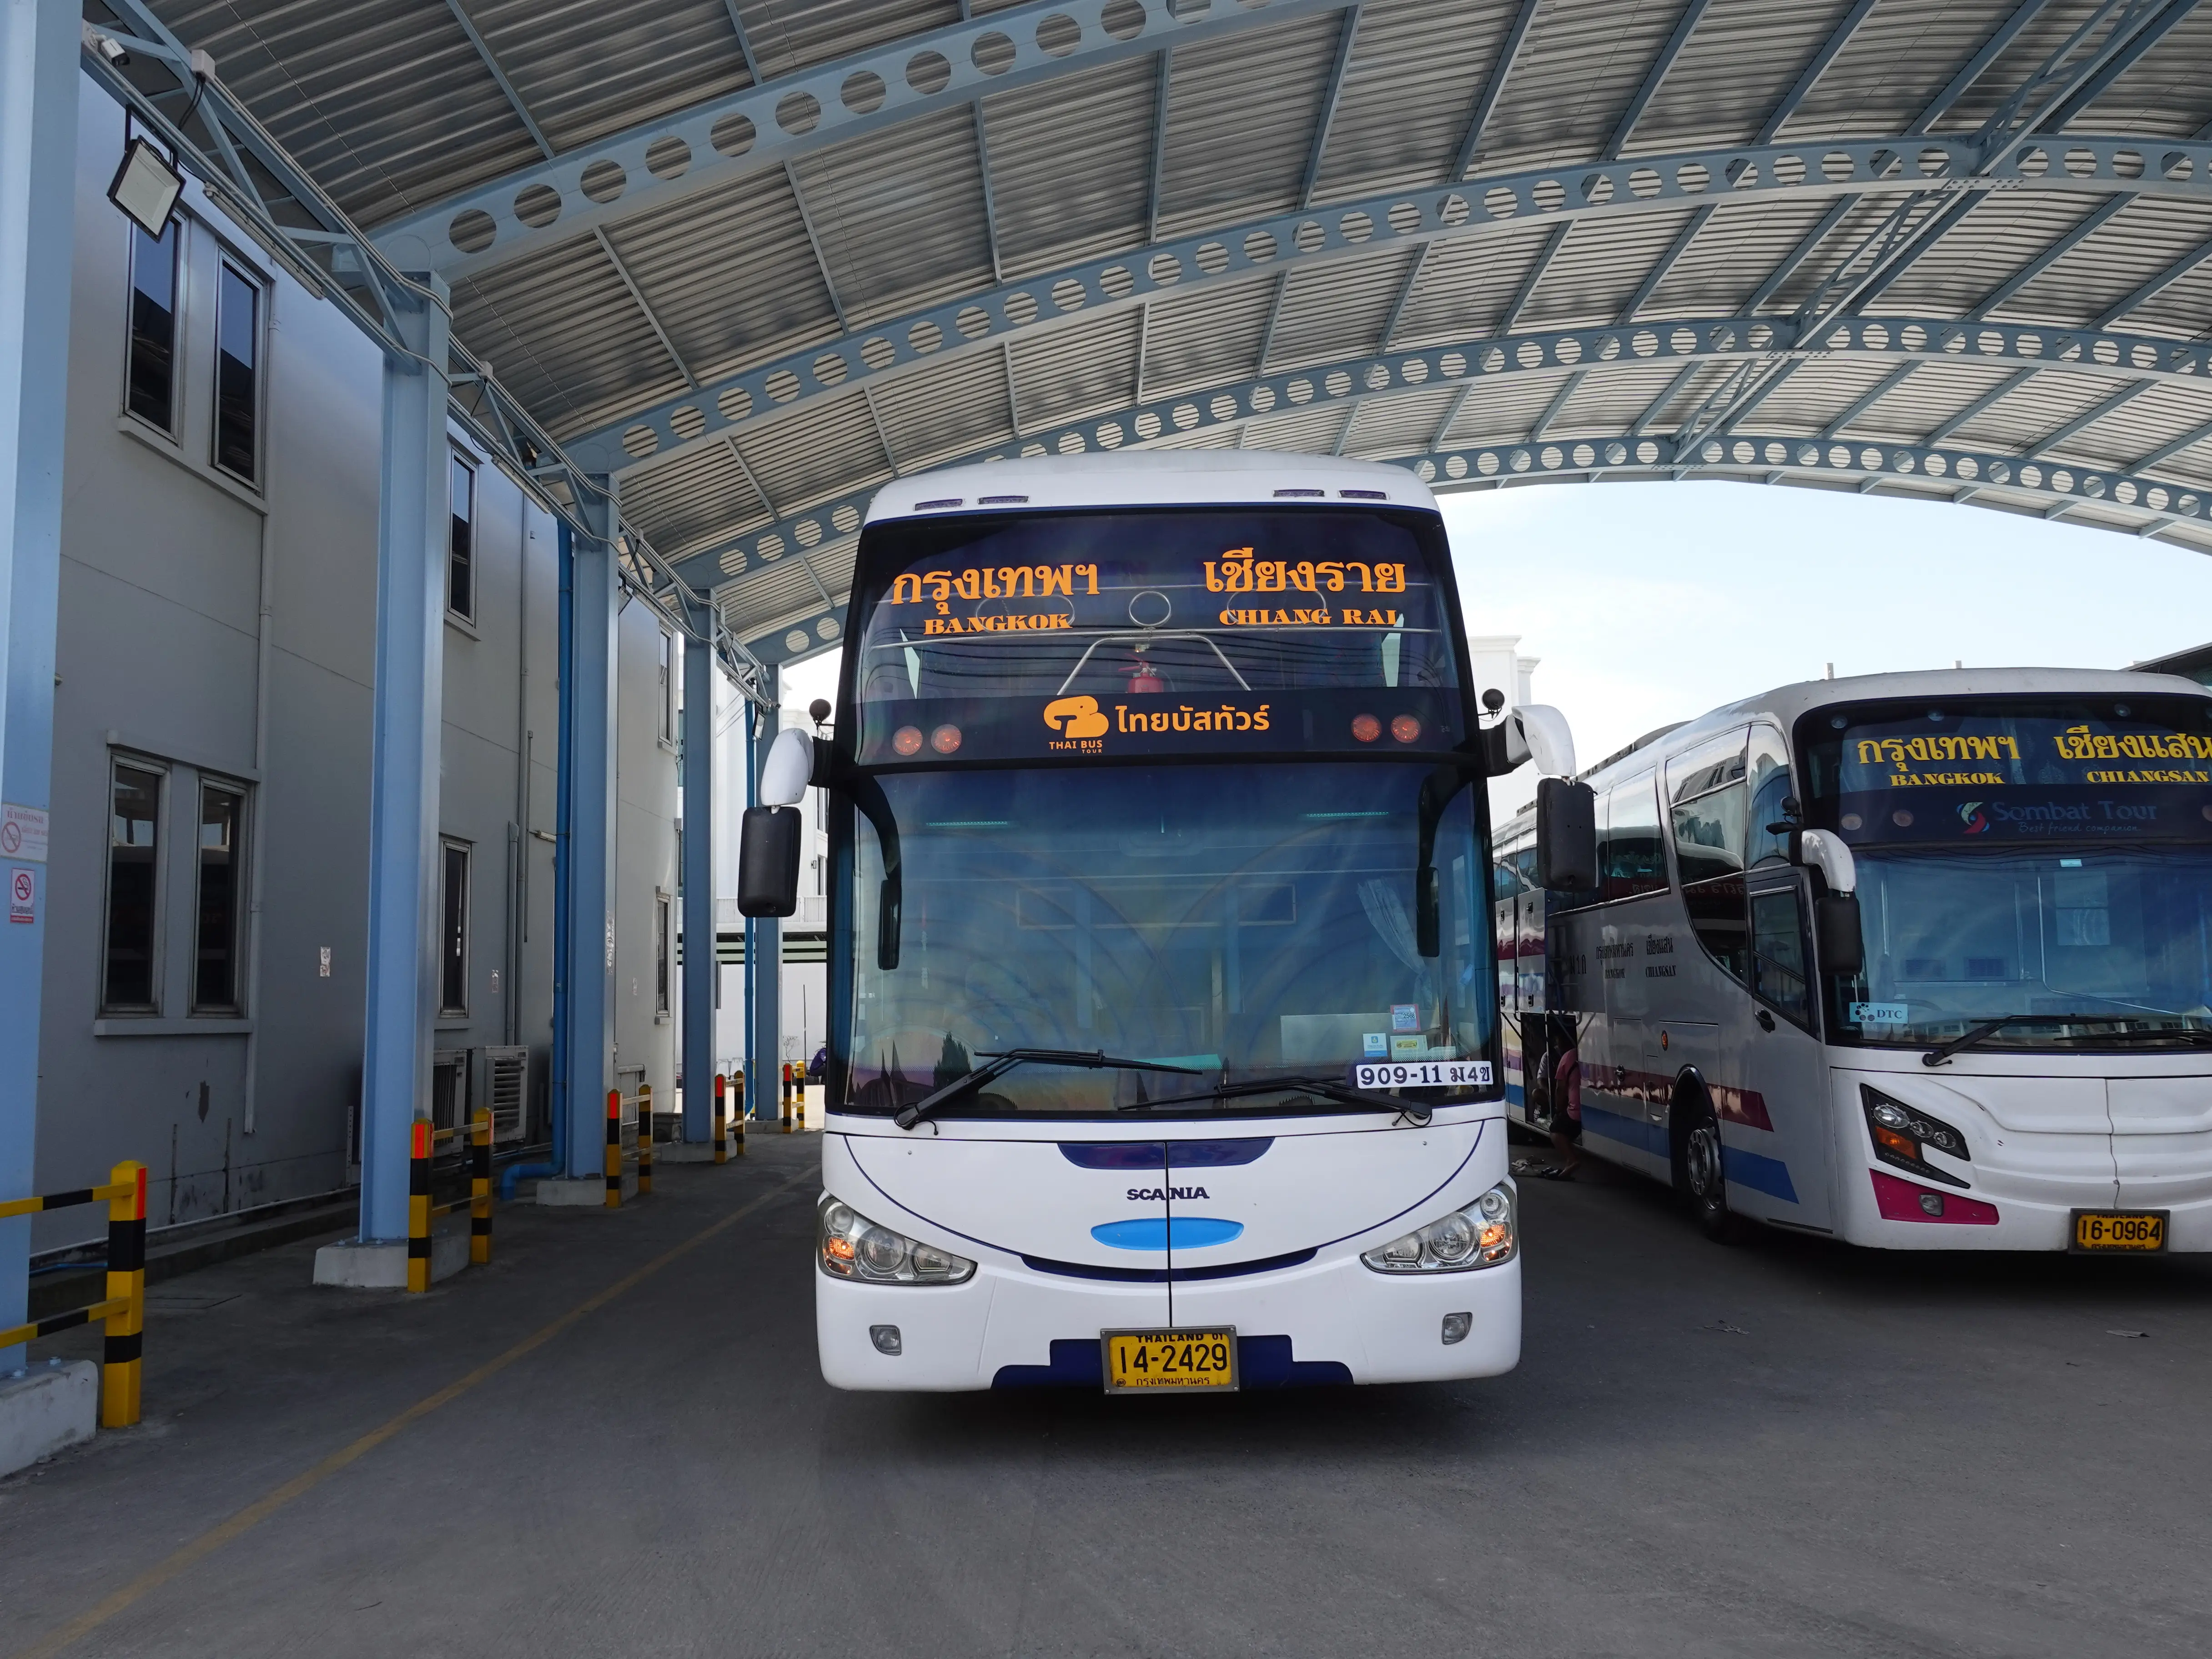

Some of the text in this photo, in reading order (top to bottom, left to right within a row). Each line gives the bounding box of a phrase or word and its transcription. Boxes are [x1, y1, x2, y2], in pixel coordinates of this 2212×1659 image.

[1203, 547, 1406, 593] เชียงราย
[891, 564, 1100, 615] กรุงเทพฯ
[923, 613, 1073, 635] BANGKOK
[1219, 608, 1398, 625] CHIANG RAI
[1115, 704, 1270, 733] ไทยบัสทัวร์
[1049, 739, 1103, 750] THAI BUS
[1857, 736, 2021, 772] กรุงเทพฯ
[1889, 773, 2006, 786] BANGKOK
[2086, 770, 2210, 783] CHIANGSAN
[1991, 800, 2157, 821] Sombat Tour
[2018, 822, 2045, 833] Best
[2048, 821, 2081, 835] friend
[1645, 965, 1676, 978] CHIANGSAN
[1877, 1009, 1902, 1019] DTC
[1361, 1065, 1442, 1085] 909-11
[1126, 1186, 1210, 1201] SCANIA
[2082, 1220, 2160, 1241] 16-0964
[1136, 1333, 1204, 1343] THAILAND
[1120, 1343, 1227, 1374] 14-2429
[1136, 1377, 1210, 1386] กรงเทพมหานคร
